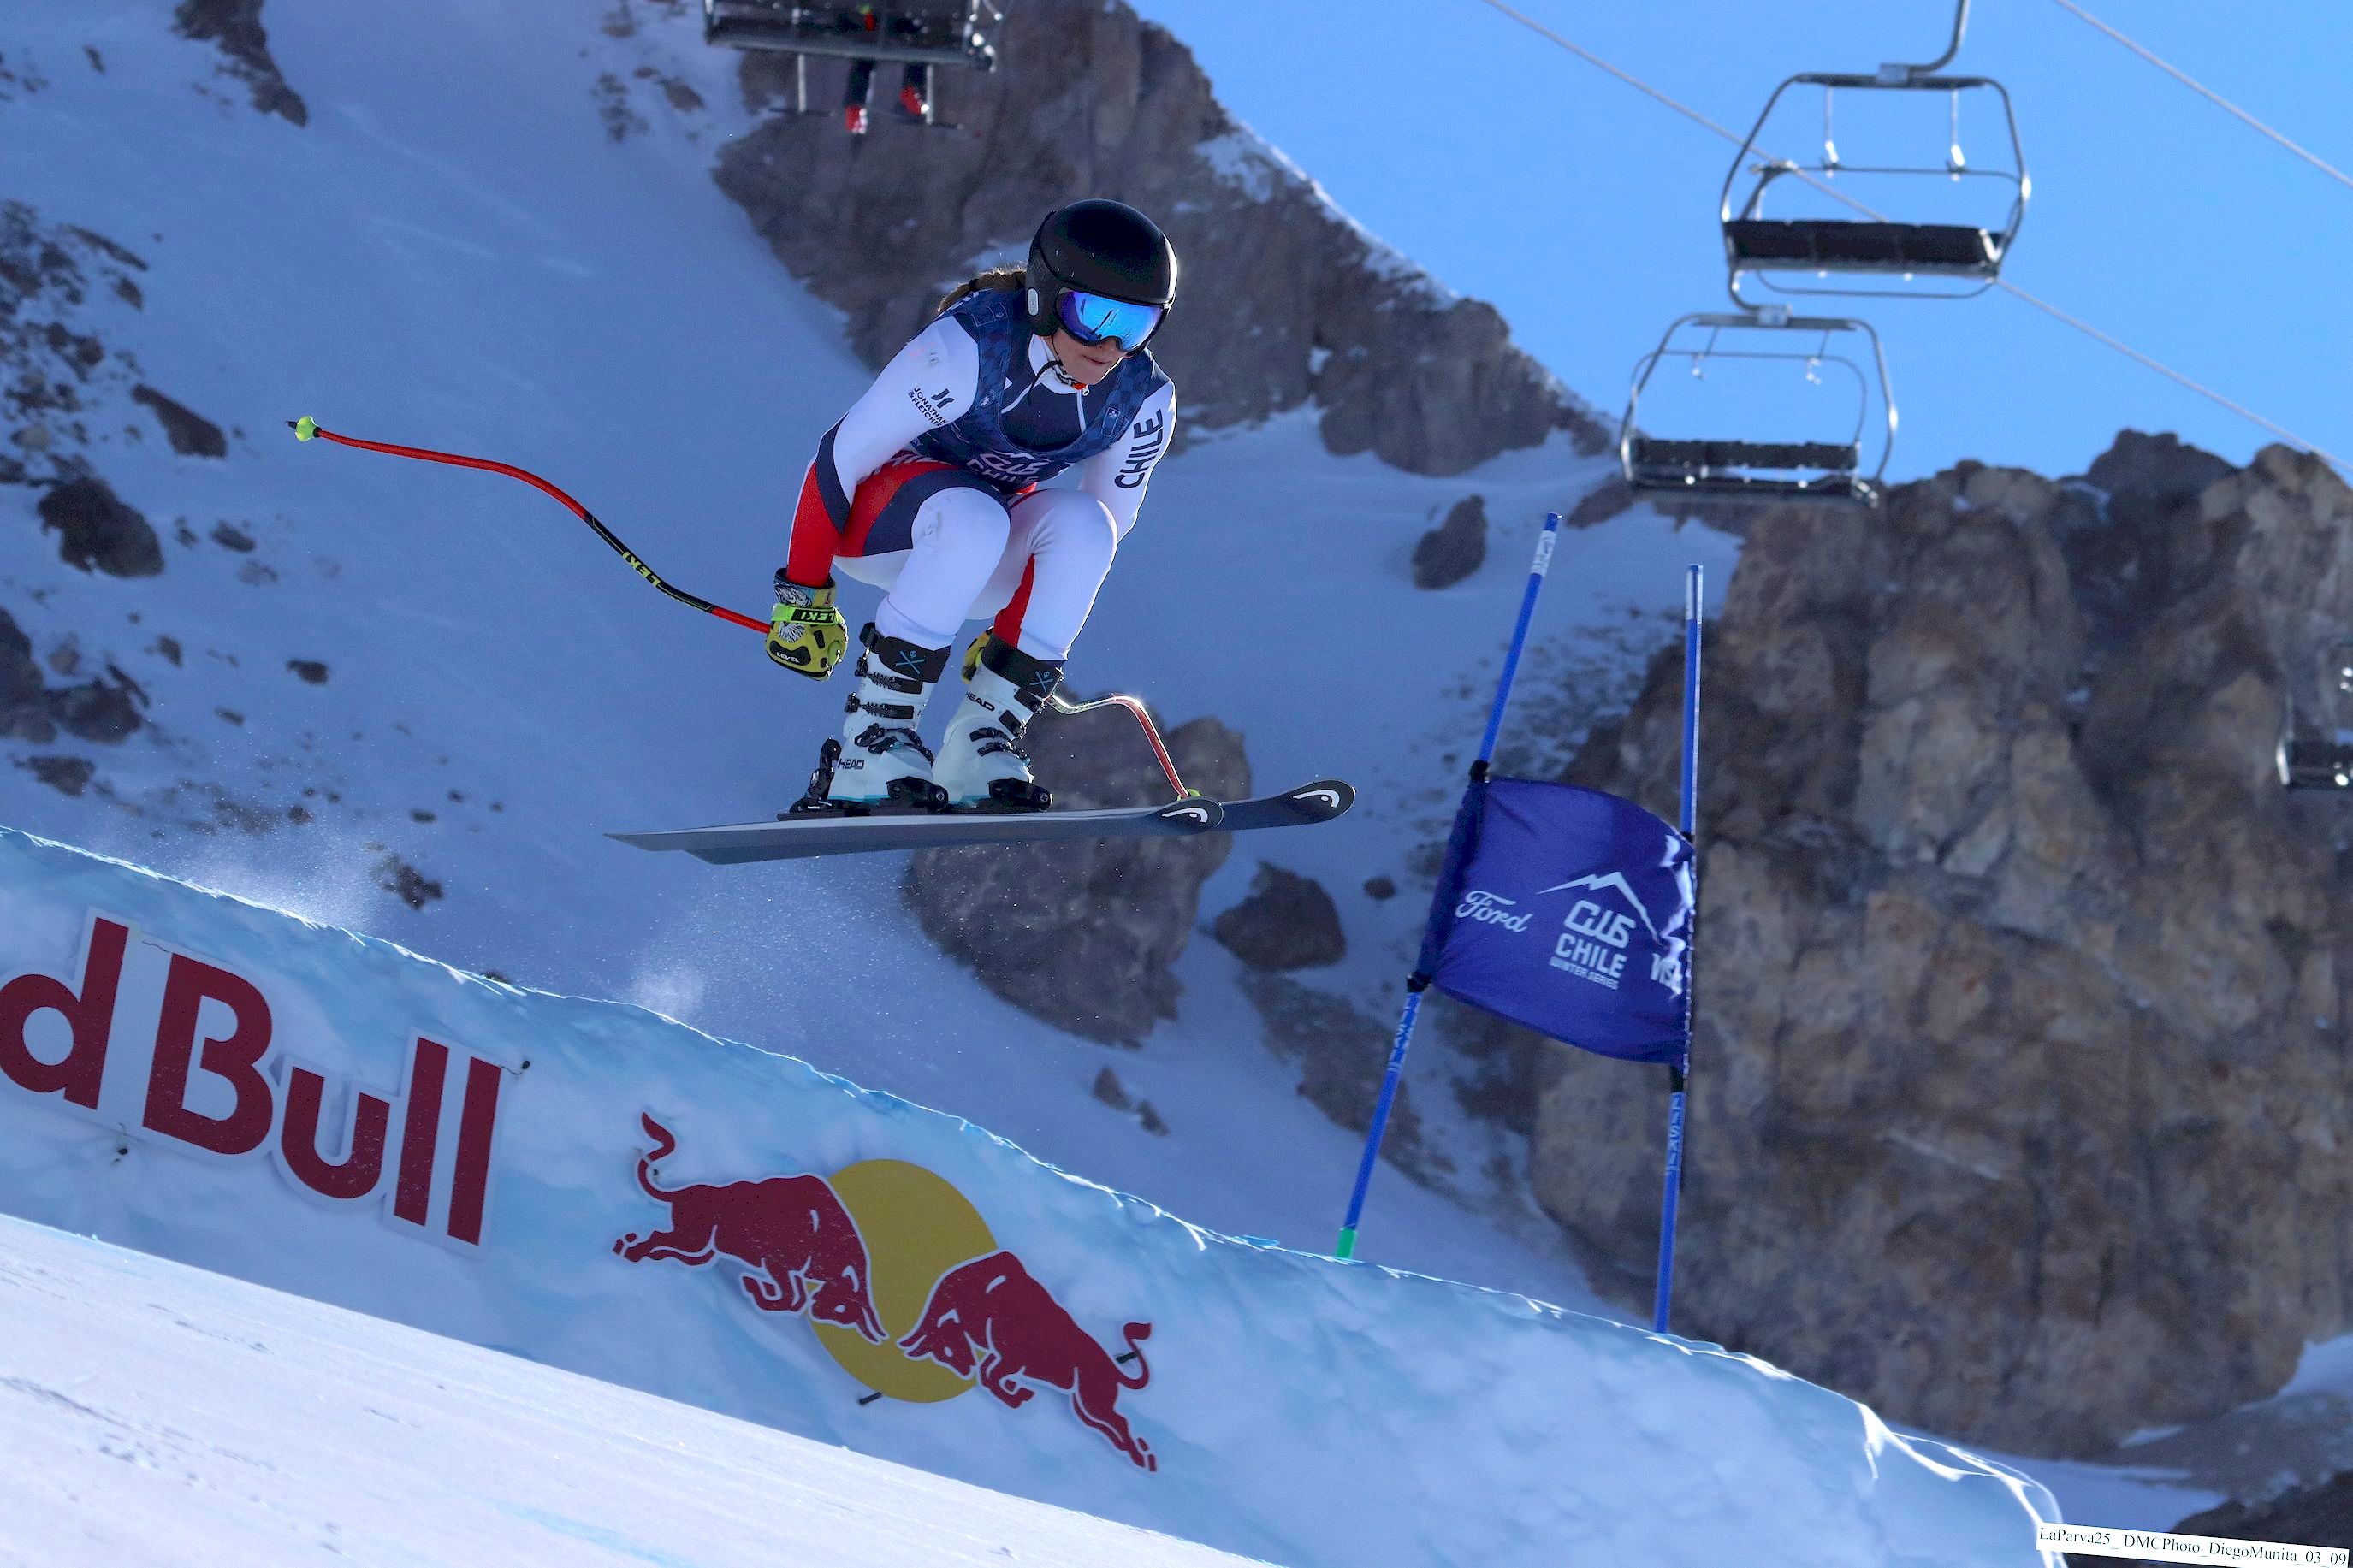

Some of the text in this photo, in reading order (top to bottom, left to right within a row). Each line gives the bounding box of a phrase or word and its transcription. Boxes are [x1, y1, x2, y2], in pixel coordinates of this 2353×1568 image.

[914, 388, 948, 424] JONATHAN
[1114, 408, 1164, 489] CHILE
[622, 551, 661, 587] LEKI
[800, 611, 836, 621] LEKI
[776, 651, 800, 664] LEVEL
[965, 691, 995, 712] HEAD
[838, 758, 865, 770] HEAD
[1455, 890, 1534, 932] Ford
[1555, 932, 1628, 979] CHILE
[142, 951, 502, 1246] Bull
